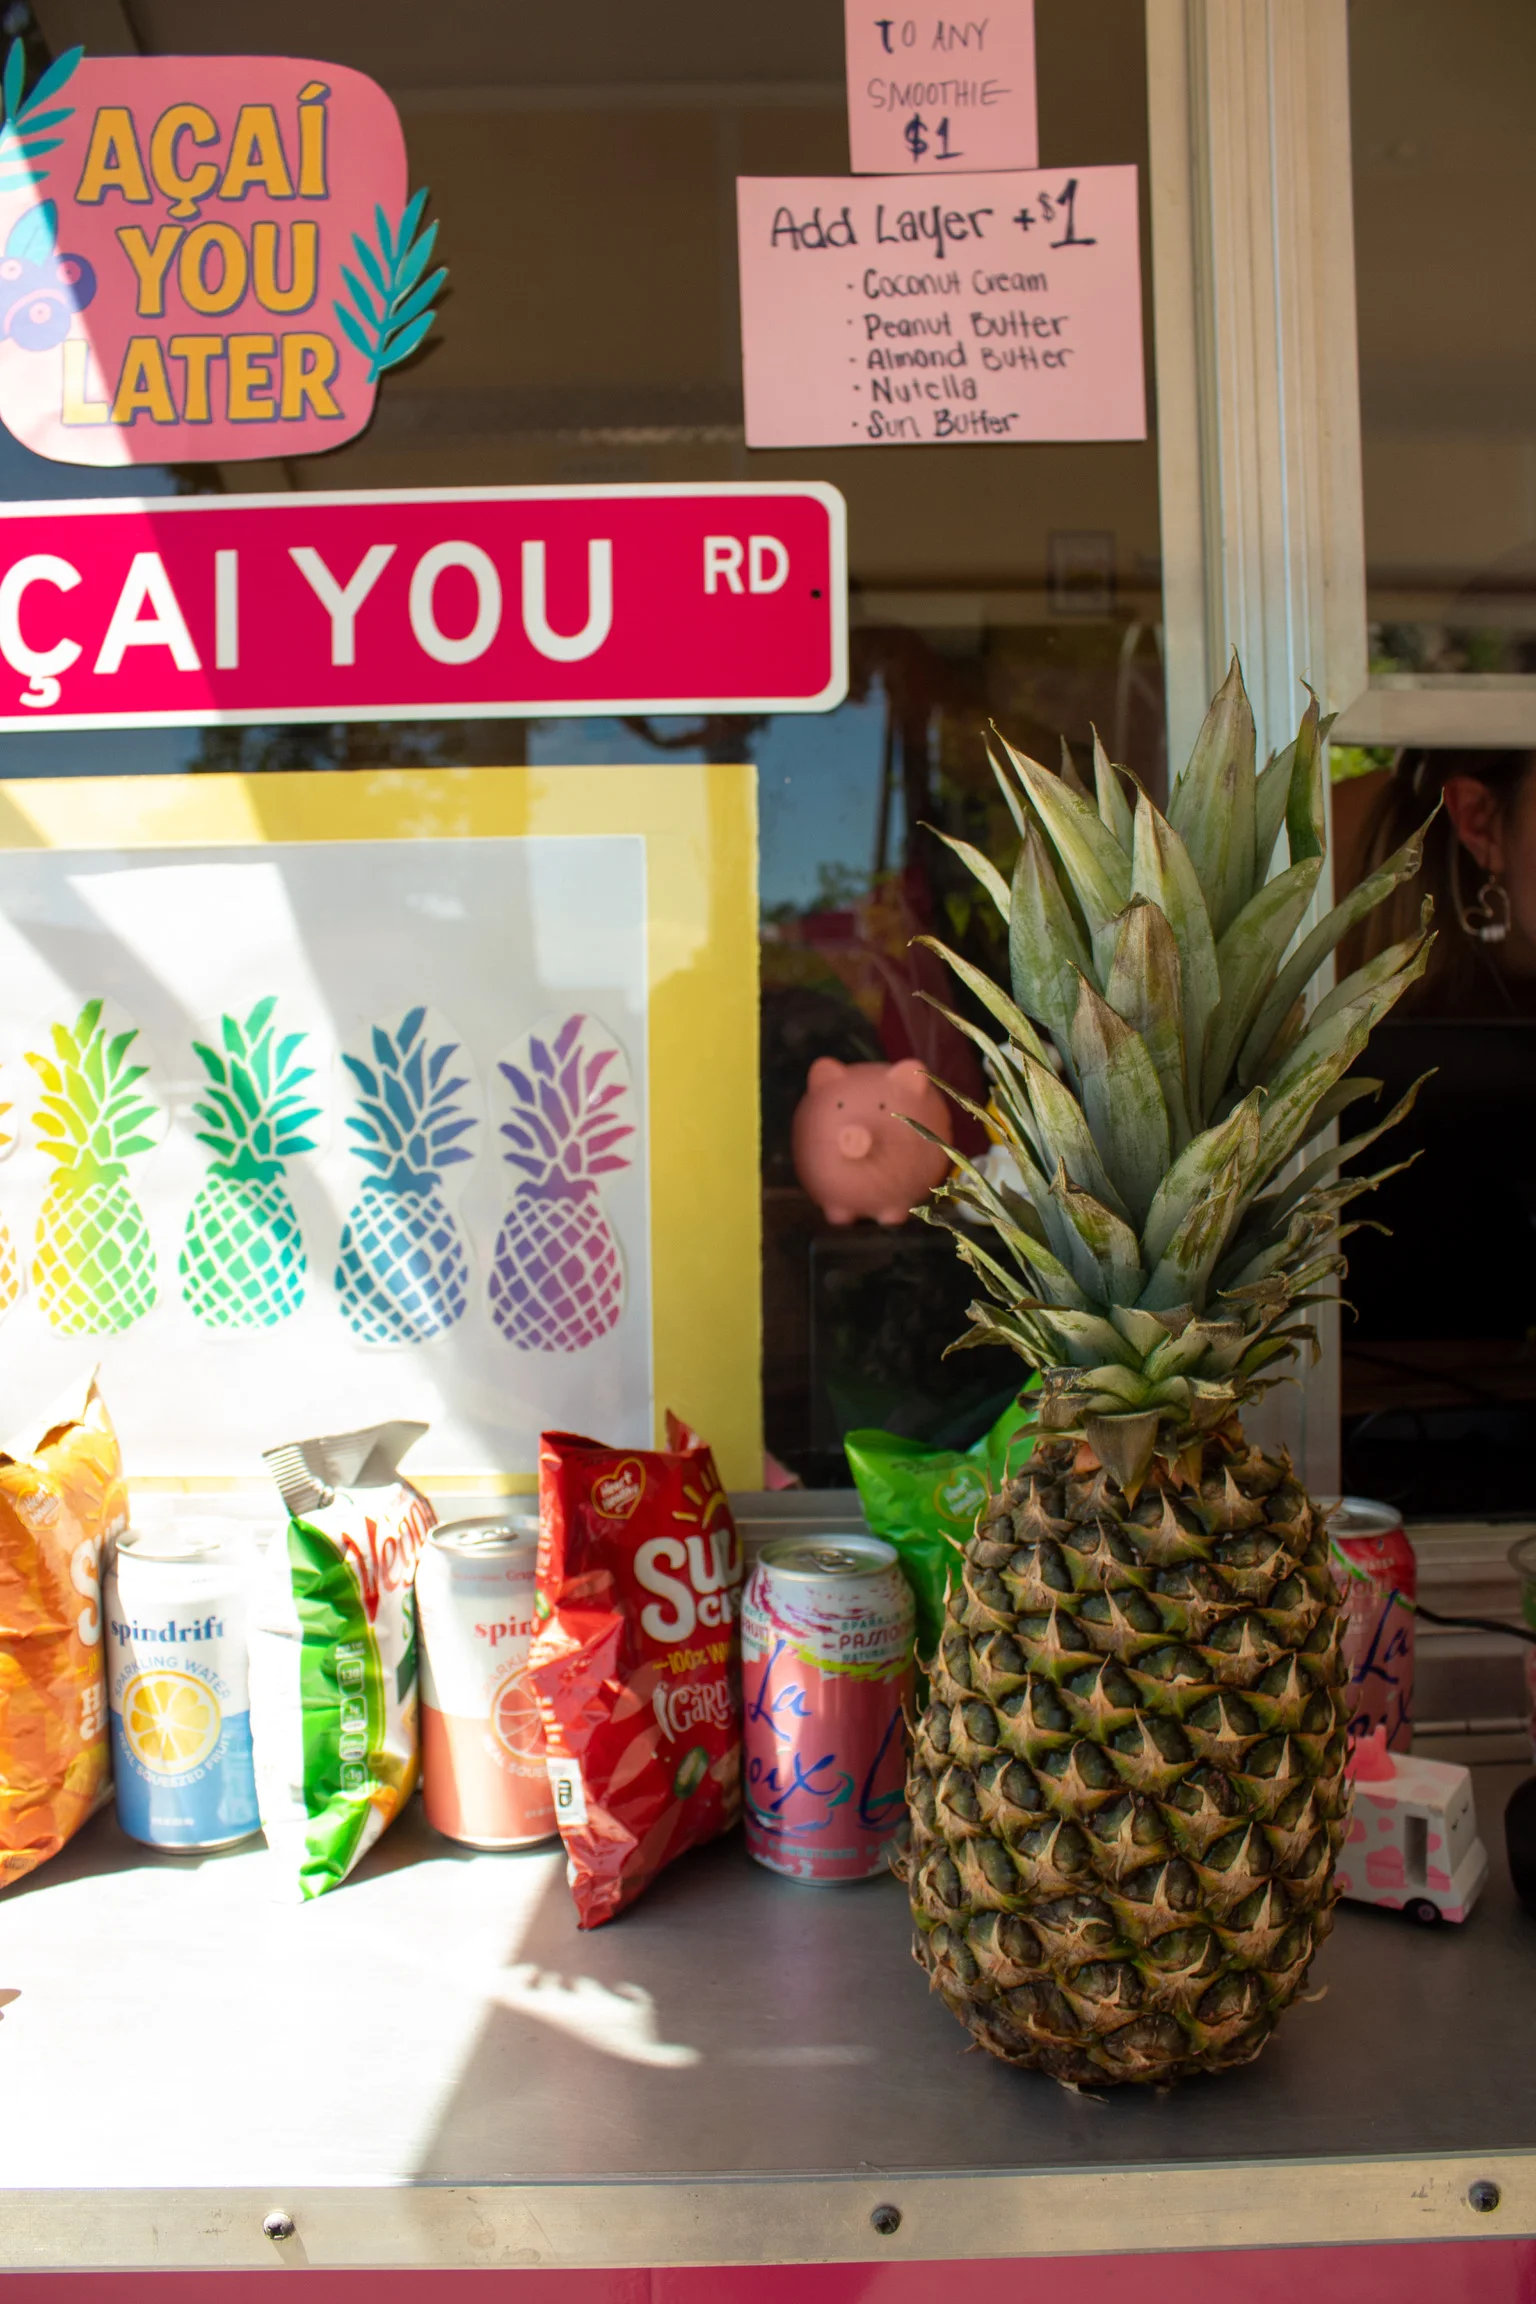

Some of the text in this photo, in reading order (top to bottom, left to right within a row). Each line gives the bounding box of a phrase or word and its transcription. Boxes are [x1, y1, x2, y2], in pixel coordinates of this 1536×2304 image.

[874, 17, 990, 54] TO ANY
[866, 77, 1013, 112] SMOOTHIE
[75, 80, 331, 220] AÇAÍ
[904, 112, 965, 162] $1
[770, 206, 858, 252] Add
[876, 205, 994, 259] Layer
[115, 220, 319, 318] YOU
[863, 268, 1049, 299] Coconut Cream
[863, 311, 1070, 341] Peanut Butter
[61, 332, 346, 427] LATER
[866, 341, 1076, 372] Almond Butter
[871, 374, 979, 405] Nutella
[866, 407, 1021, 439] Sun Butter
[287, 539, 613, 667] YOU
[703, 534, 790, 595] RD
[111, 1615, 229, 1647] spindrift
[1351, 1588, 1408, 1684] La
[114, 1656, 178, 1699] SPARKLING
[185, 1658, 232, 1700] WATER
[748, 1639, 813, 1742] La
[750, 1752, 836, 1812] oix
